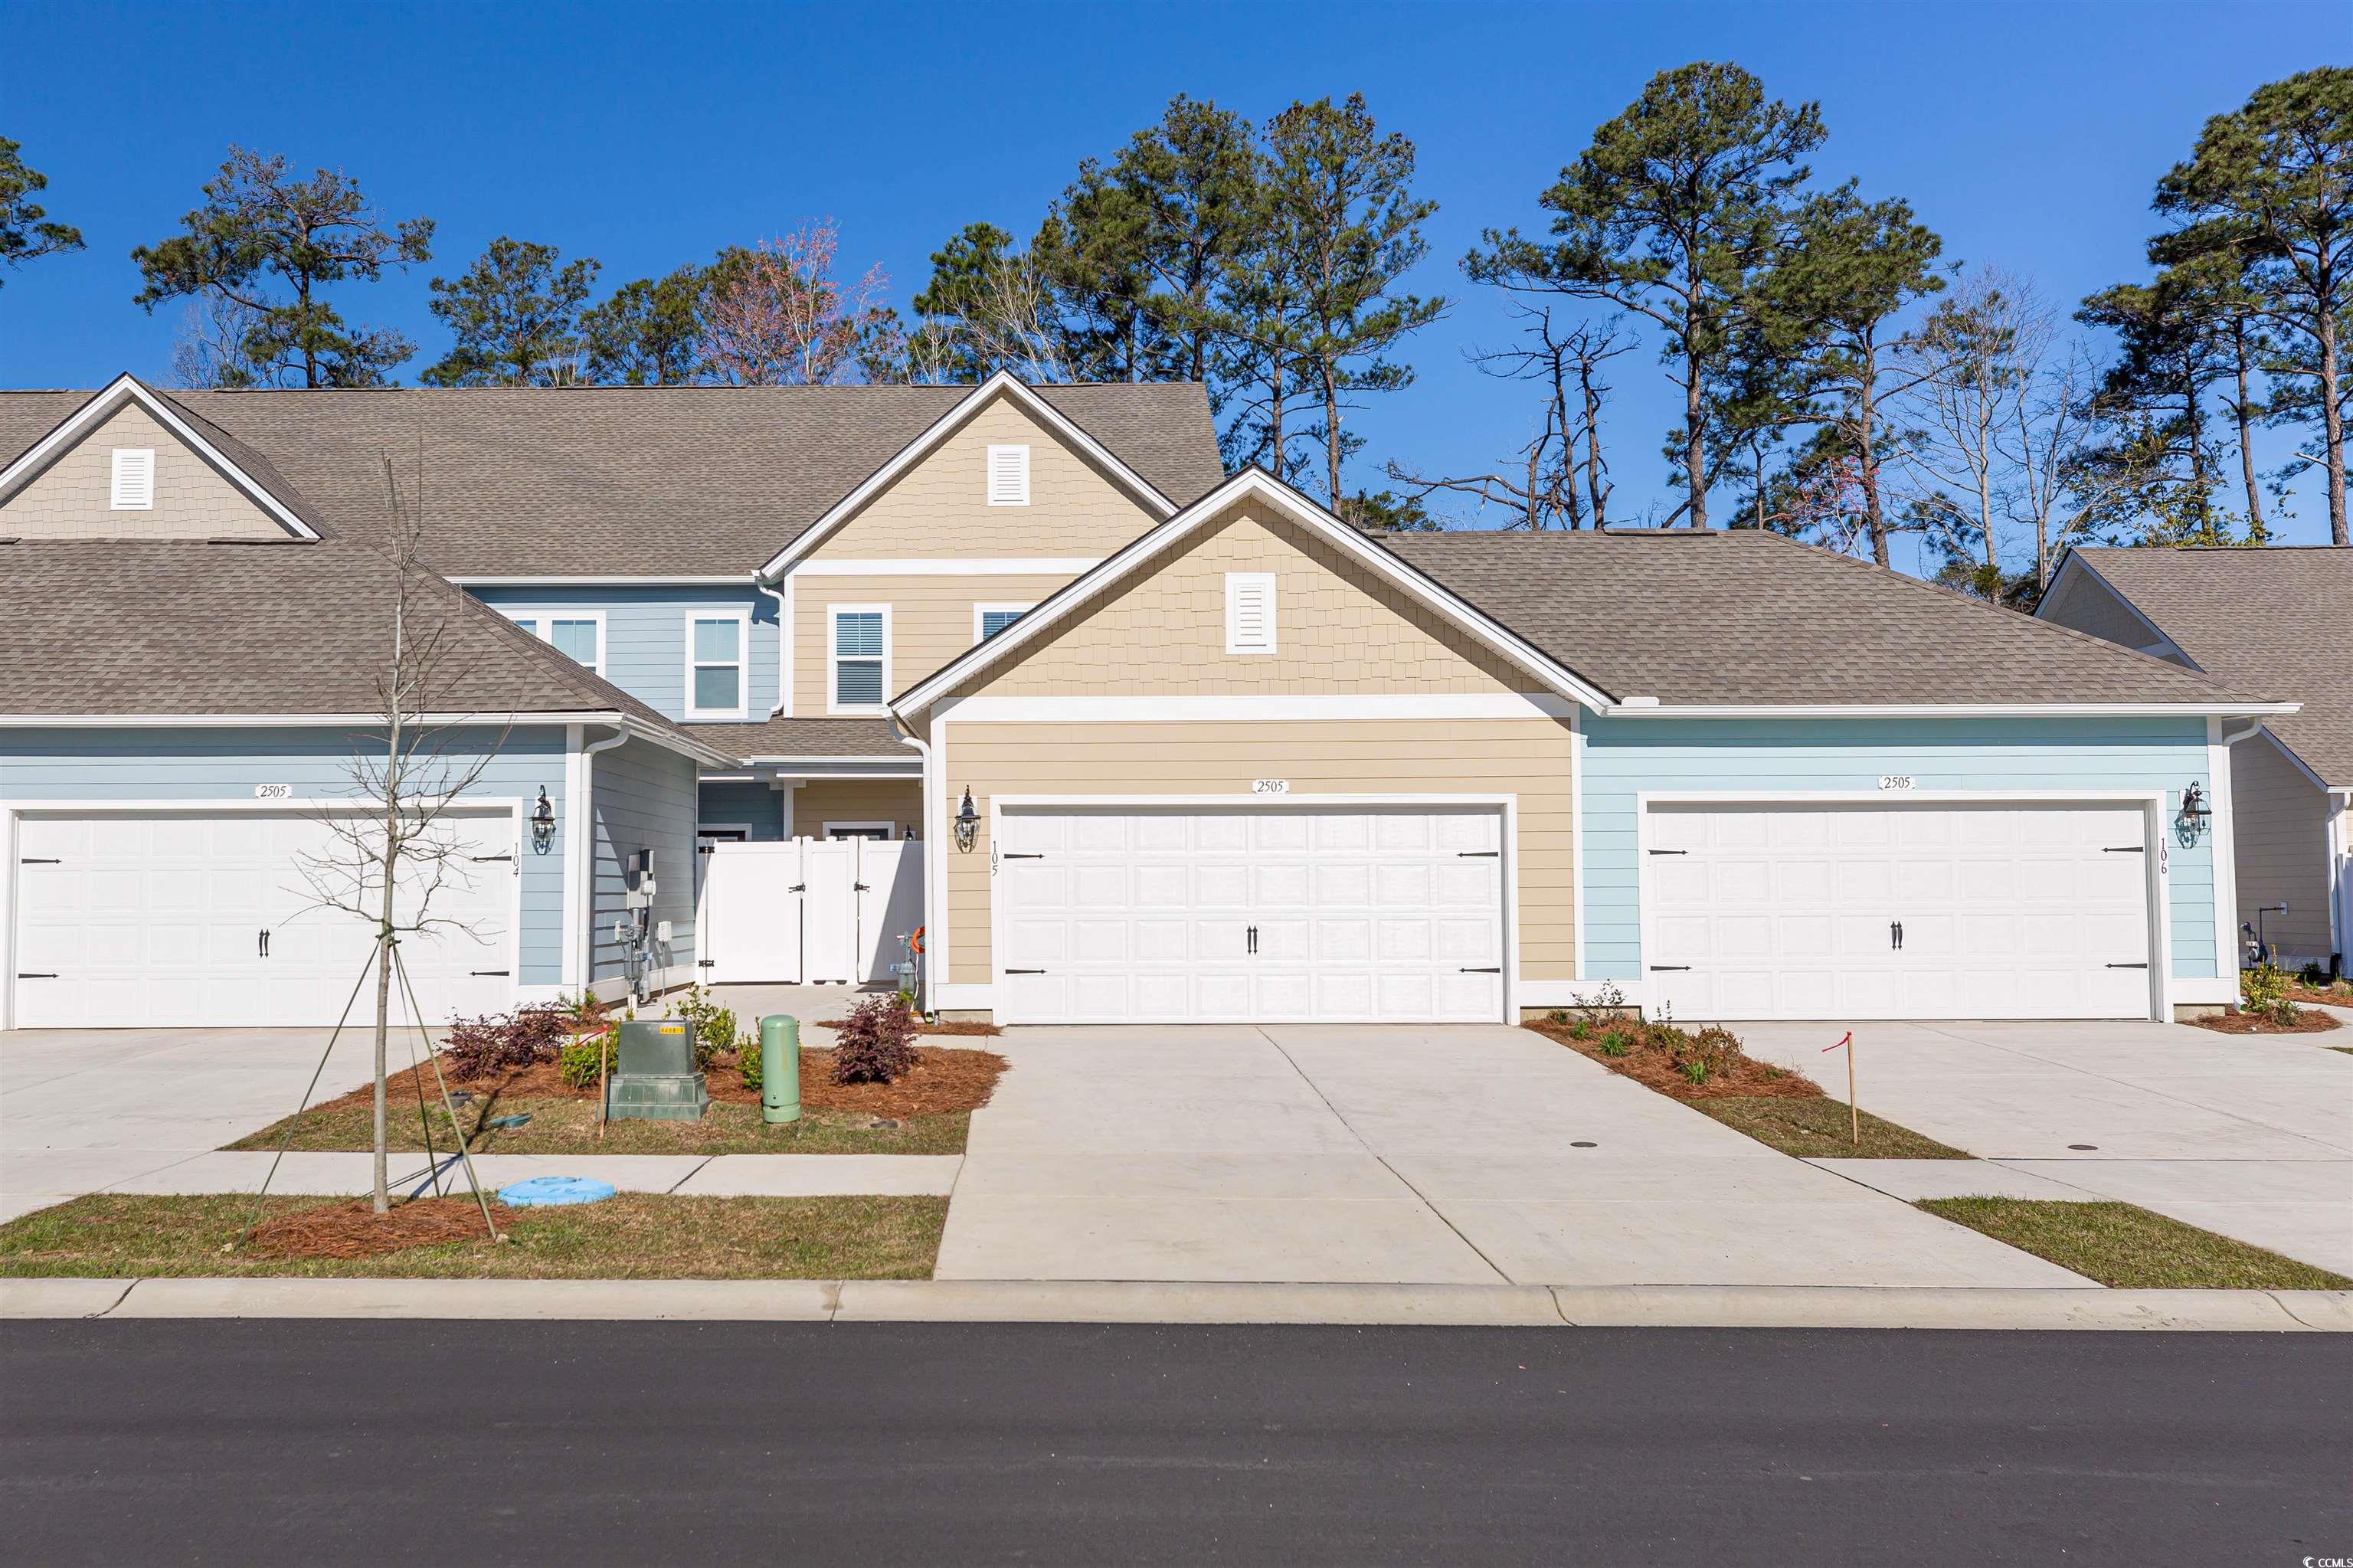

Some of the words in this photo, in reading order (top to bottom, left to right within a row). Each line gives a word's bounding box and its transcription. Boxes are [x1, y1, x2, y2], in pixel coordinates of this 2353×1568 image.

[1257, 781, 1284, 792] 2505
[1884, 776, 1911, 789] 2505
[260, 785, 287, 797] 2505
